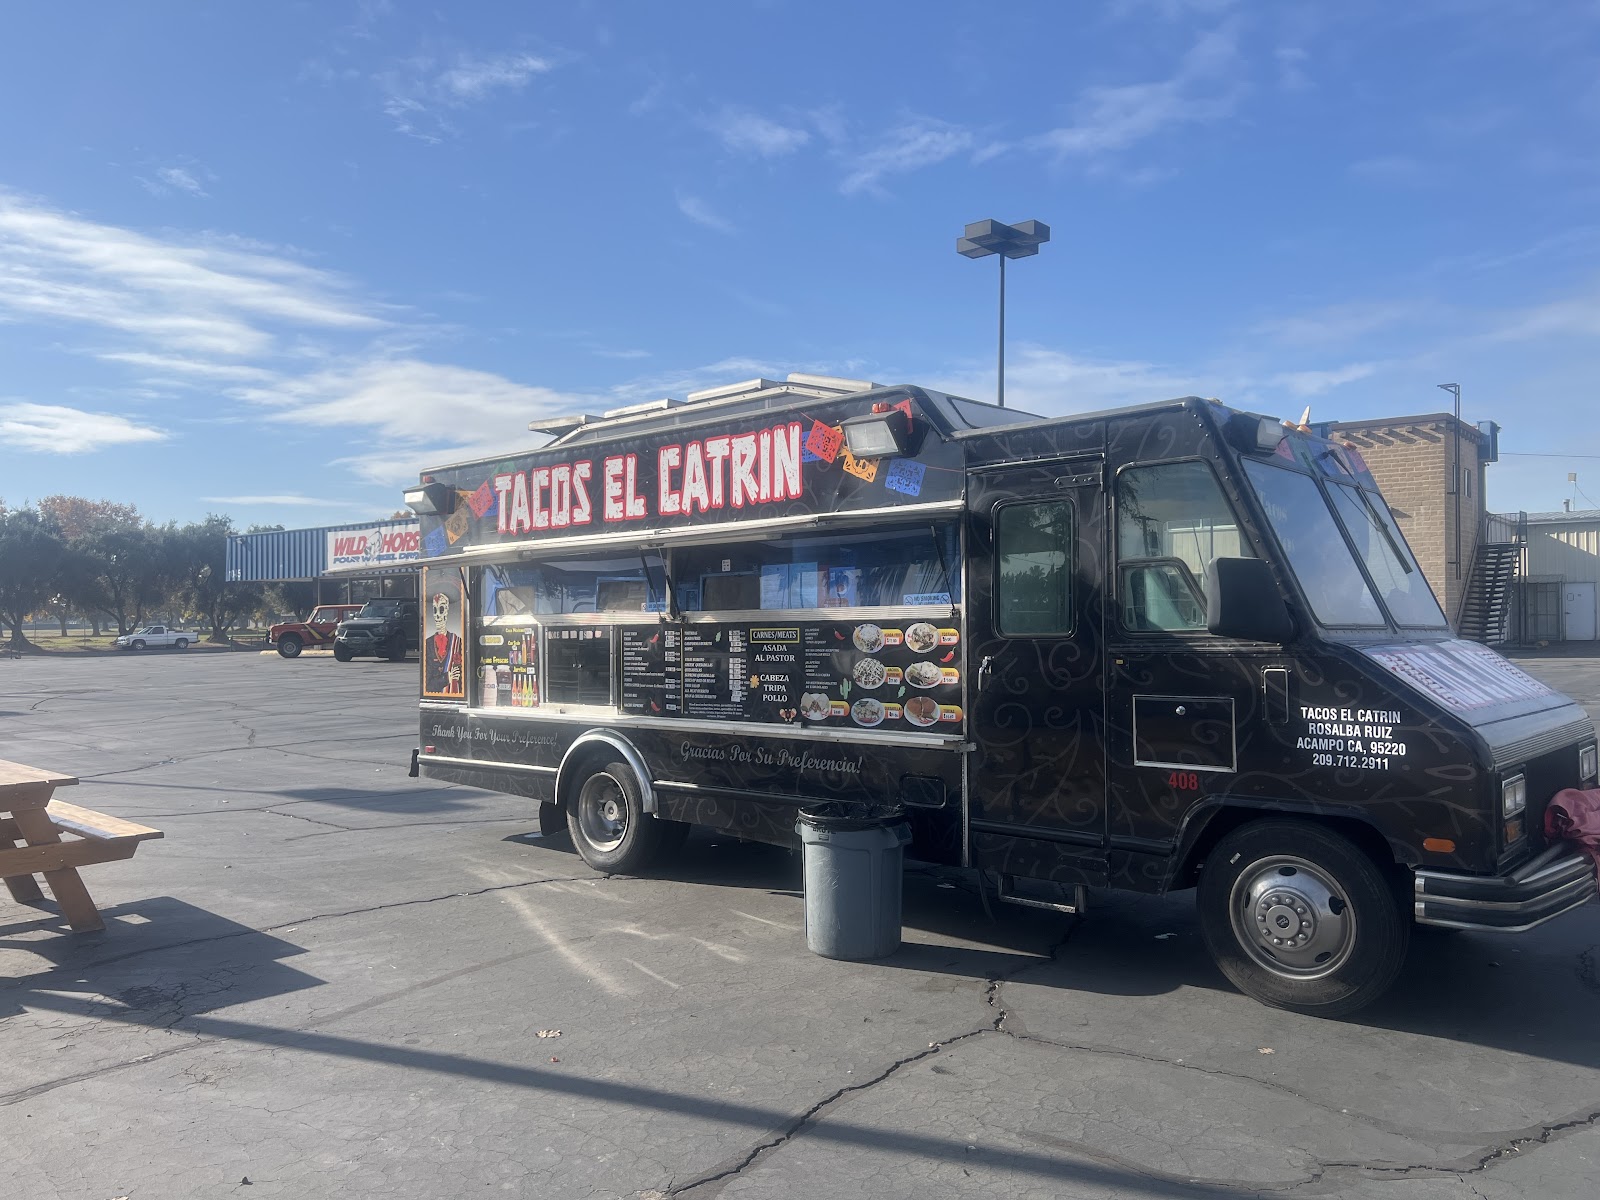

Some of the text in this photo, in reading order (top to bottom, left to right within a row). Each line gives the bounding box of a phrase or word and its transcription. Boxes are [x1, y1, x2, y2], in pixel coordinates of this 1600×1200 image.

[494, 422, 803, 535] TACOS EL CATRIN
[334, 531, 420, 557] WILD HORS
[333, 556, 360, 564] FOUR
[753, 631, 797, 640] CARNES/MEATS
[760, 674, 789, 682] CABEZA
[763, 684, 786, 692] TRIPA
[762, 694, 788, 702] POLLO
[1300, 707, 1401, 724] TACOS EL CATRIN
[431, 725, 558, 747] Thank You For Your Preference!
[1308, 722, 1393, 739] ROSALBA RUIZ
[1296, 737, 1406, 756] ACAMPO CA, 95220
[680, 740, 863, 774] Gracias Por Su Preferencia!
[1312, 753, 1389, 771] 209.712.2911
[1168, 772, 1198, 791] 408
